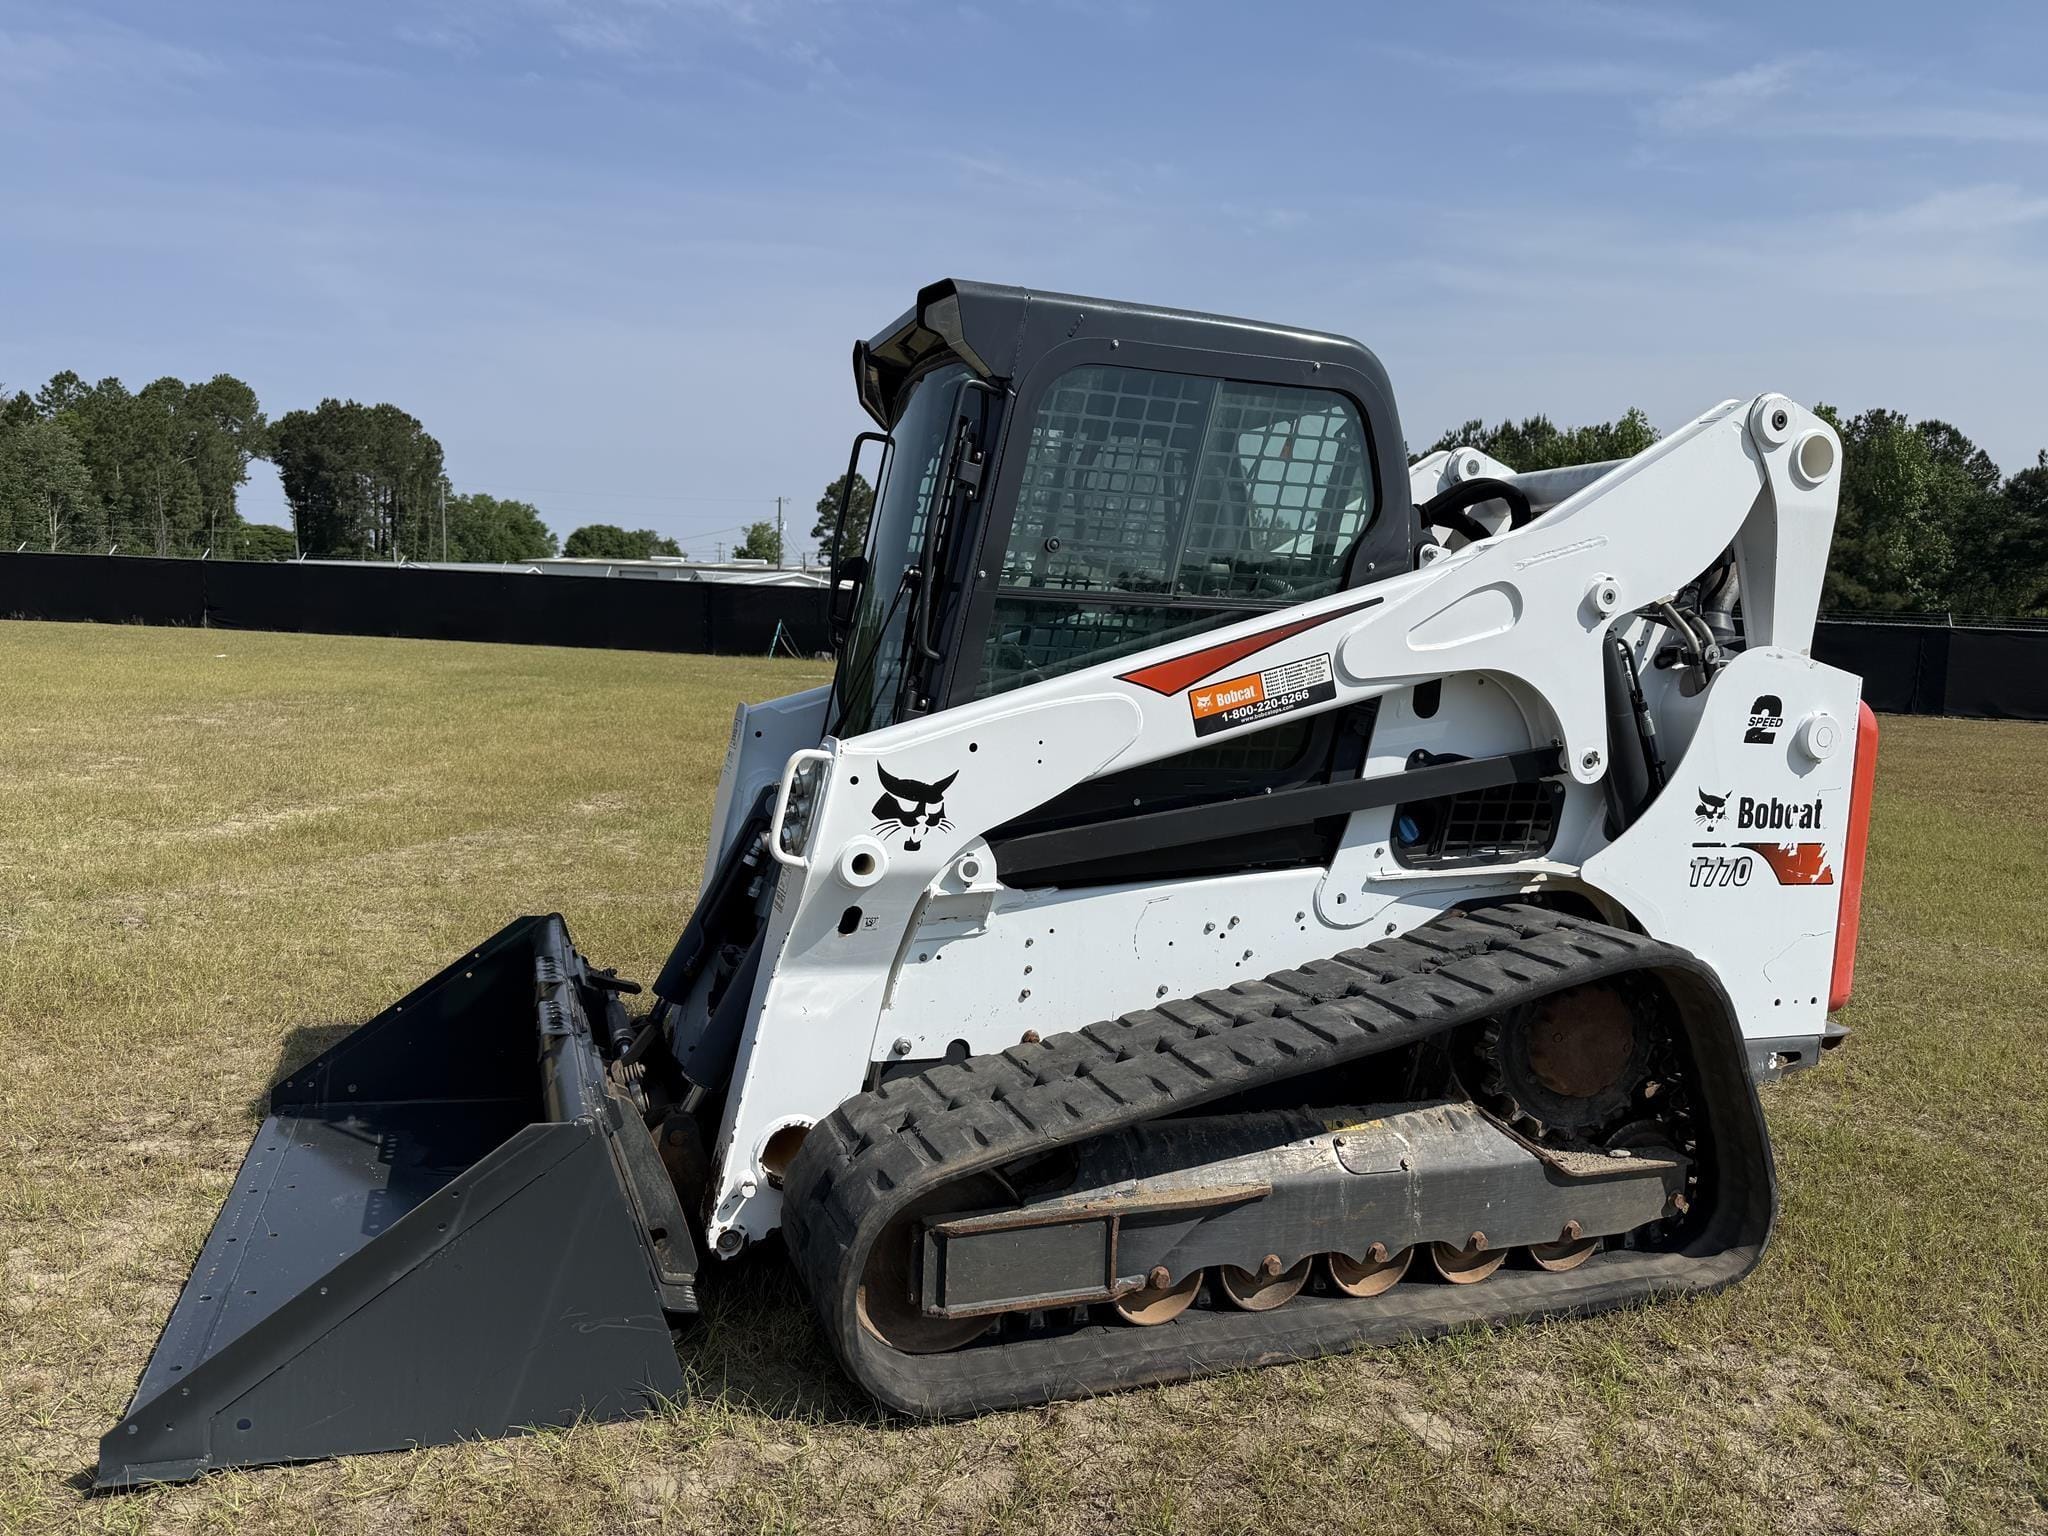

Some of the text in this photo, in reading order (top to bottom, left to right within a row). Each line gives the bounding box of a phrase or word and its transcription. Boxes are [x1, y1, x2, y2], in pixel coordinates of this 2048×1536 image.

[1216, 685, 1256, 707] Bobcat
[1222, 689, 1310, 722] 1-800-220-6266
[1744, 694, 1783, 745] 2
[1748, 716, 1784, 728] SPEED
[1737, 796, 1823, 830] Bobcat
[1689, 856, 1753, 887] T770
